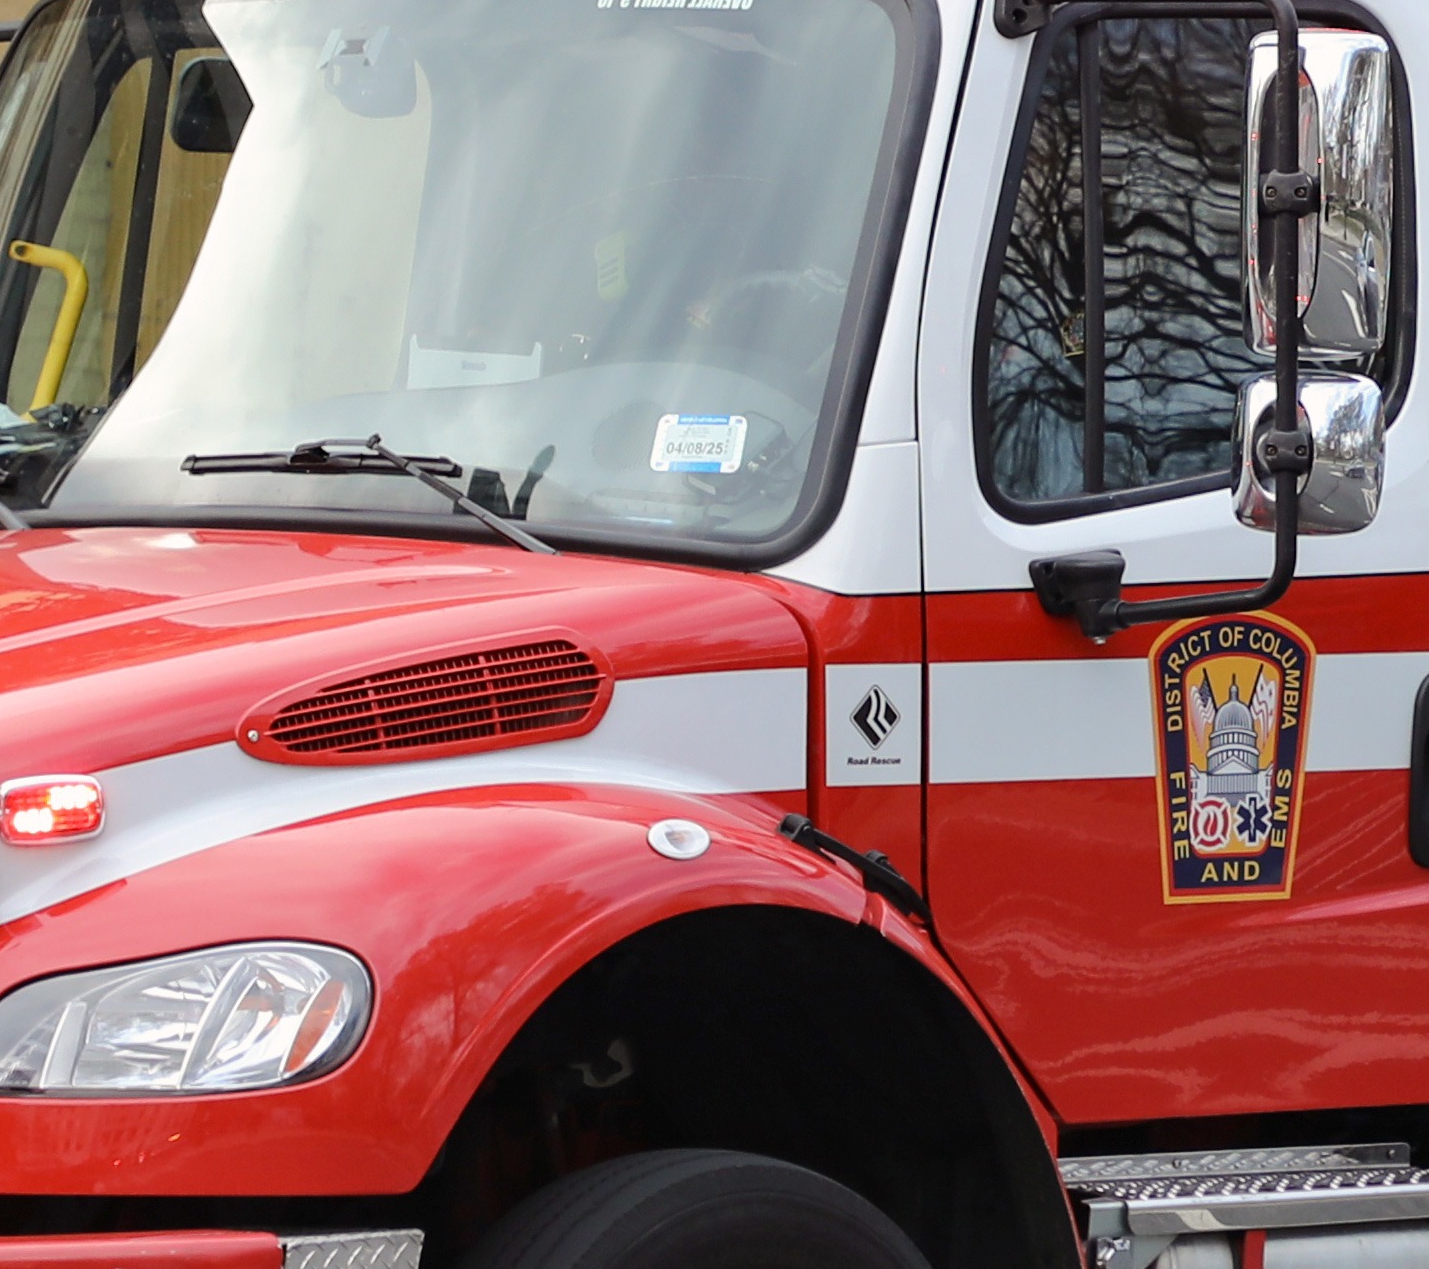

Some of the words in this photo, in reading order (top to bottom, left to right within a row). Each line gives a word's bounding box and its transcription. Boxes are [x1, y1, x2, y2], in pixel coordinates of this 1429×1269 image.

[666, 441, 724, 456] 04/08/25
[1164, 630, 1213, 732] DISTRICT
[1218, 626, 1245, 648] OF
[1249, 628, 1300, 730] COLUMBIA
[847, 756, 869, 766] Road
[870, 756, 901, 766] Rescue
[1169, 770, 1190, 861] FIRE
[1200, 860, 1261, 883] AND
[1270, 768, 1293, 848] EMS
